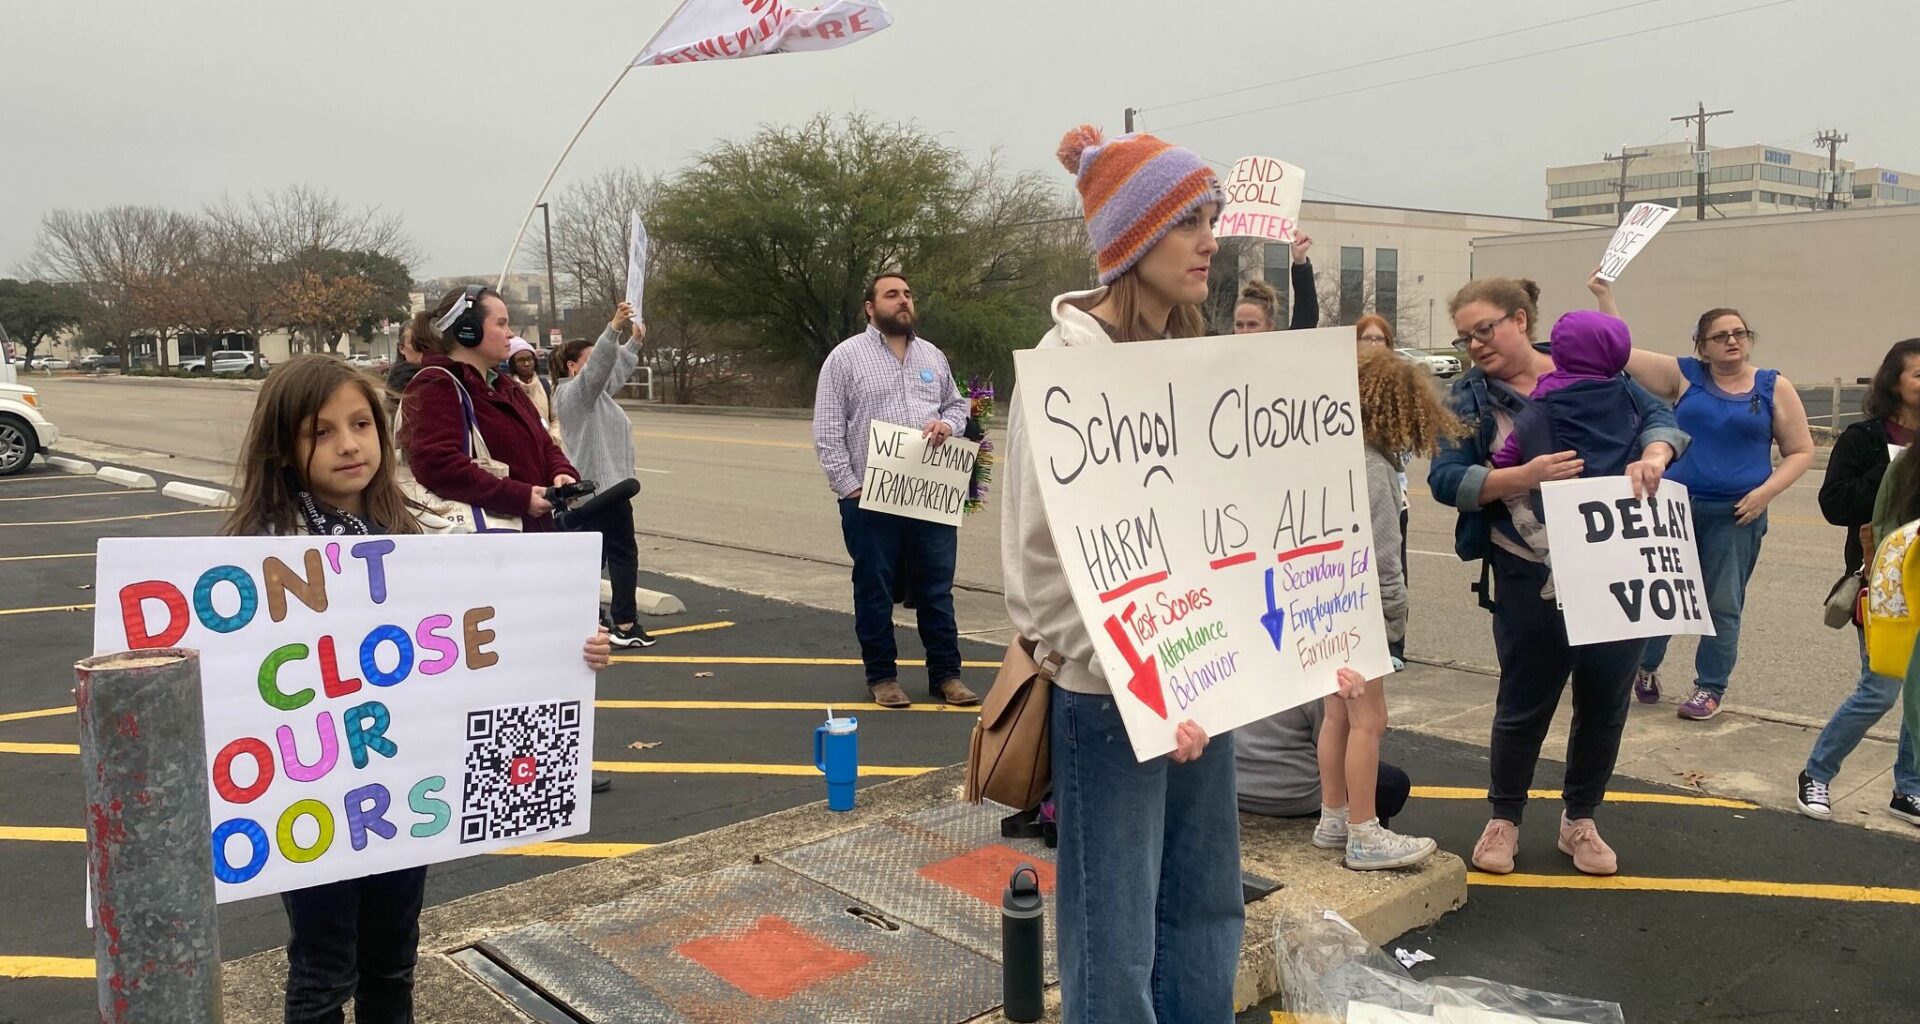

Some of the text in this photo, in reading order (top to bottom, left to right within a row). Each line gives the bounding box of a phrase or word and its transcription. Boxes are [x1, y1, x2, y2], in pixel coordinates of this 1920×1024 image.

[1227, 183, 1280, 206] SCOLL
[1236, 157, 1283, 182] END
[1220, 212, 1293, 240] MATTER
[1610, 231, 1644, 254] OSE
[1600, 252, 1627, 278] SCOLL
[872, 428, 976, 474] WE DEMAND
[1045, 382, 1356, 485] School Closures
[867, 466, 966, 515] TRANSPARENCY
[1076, 469, 1360, 590] HARM US ALL!
[1578, 497, 1689, 543] DELAY
[1283, 546, 1369, 599] Secondary Ed
[1640, 546, 1683, 574] THE
[119, 539, 396, 650] DON'T
[1121, 588, 1213, 646] Test Scores
[1290, 582, 1369, 635] Employment
[1609, 578, 1702, 623] VOTE
[257, 606, 499, 711] CLOSE
[1158, 621, 1228, 674] Attendance
[1297, 626, 1361, 672] Earnings
[1170, 651, 1239, 711] Behavior
[212, 700, 398, 805] OUR
[211, 775, 452, 884] OORS
